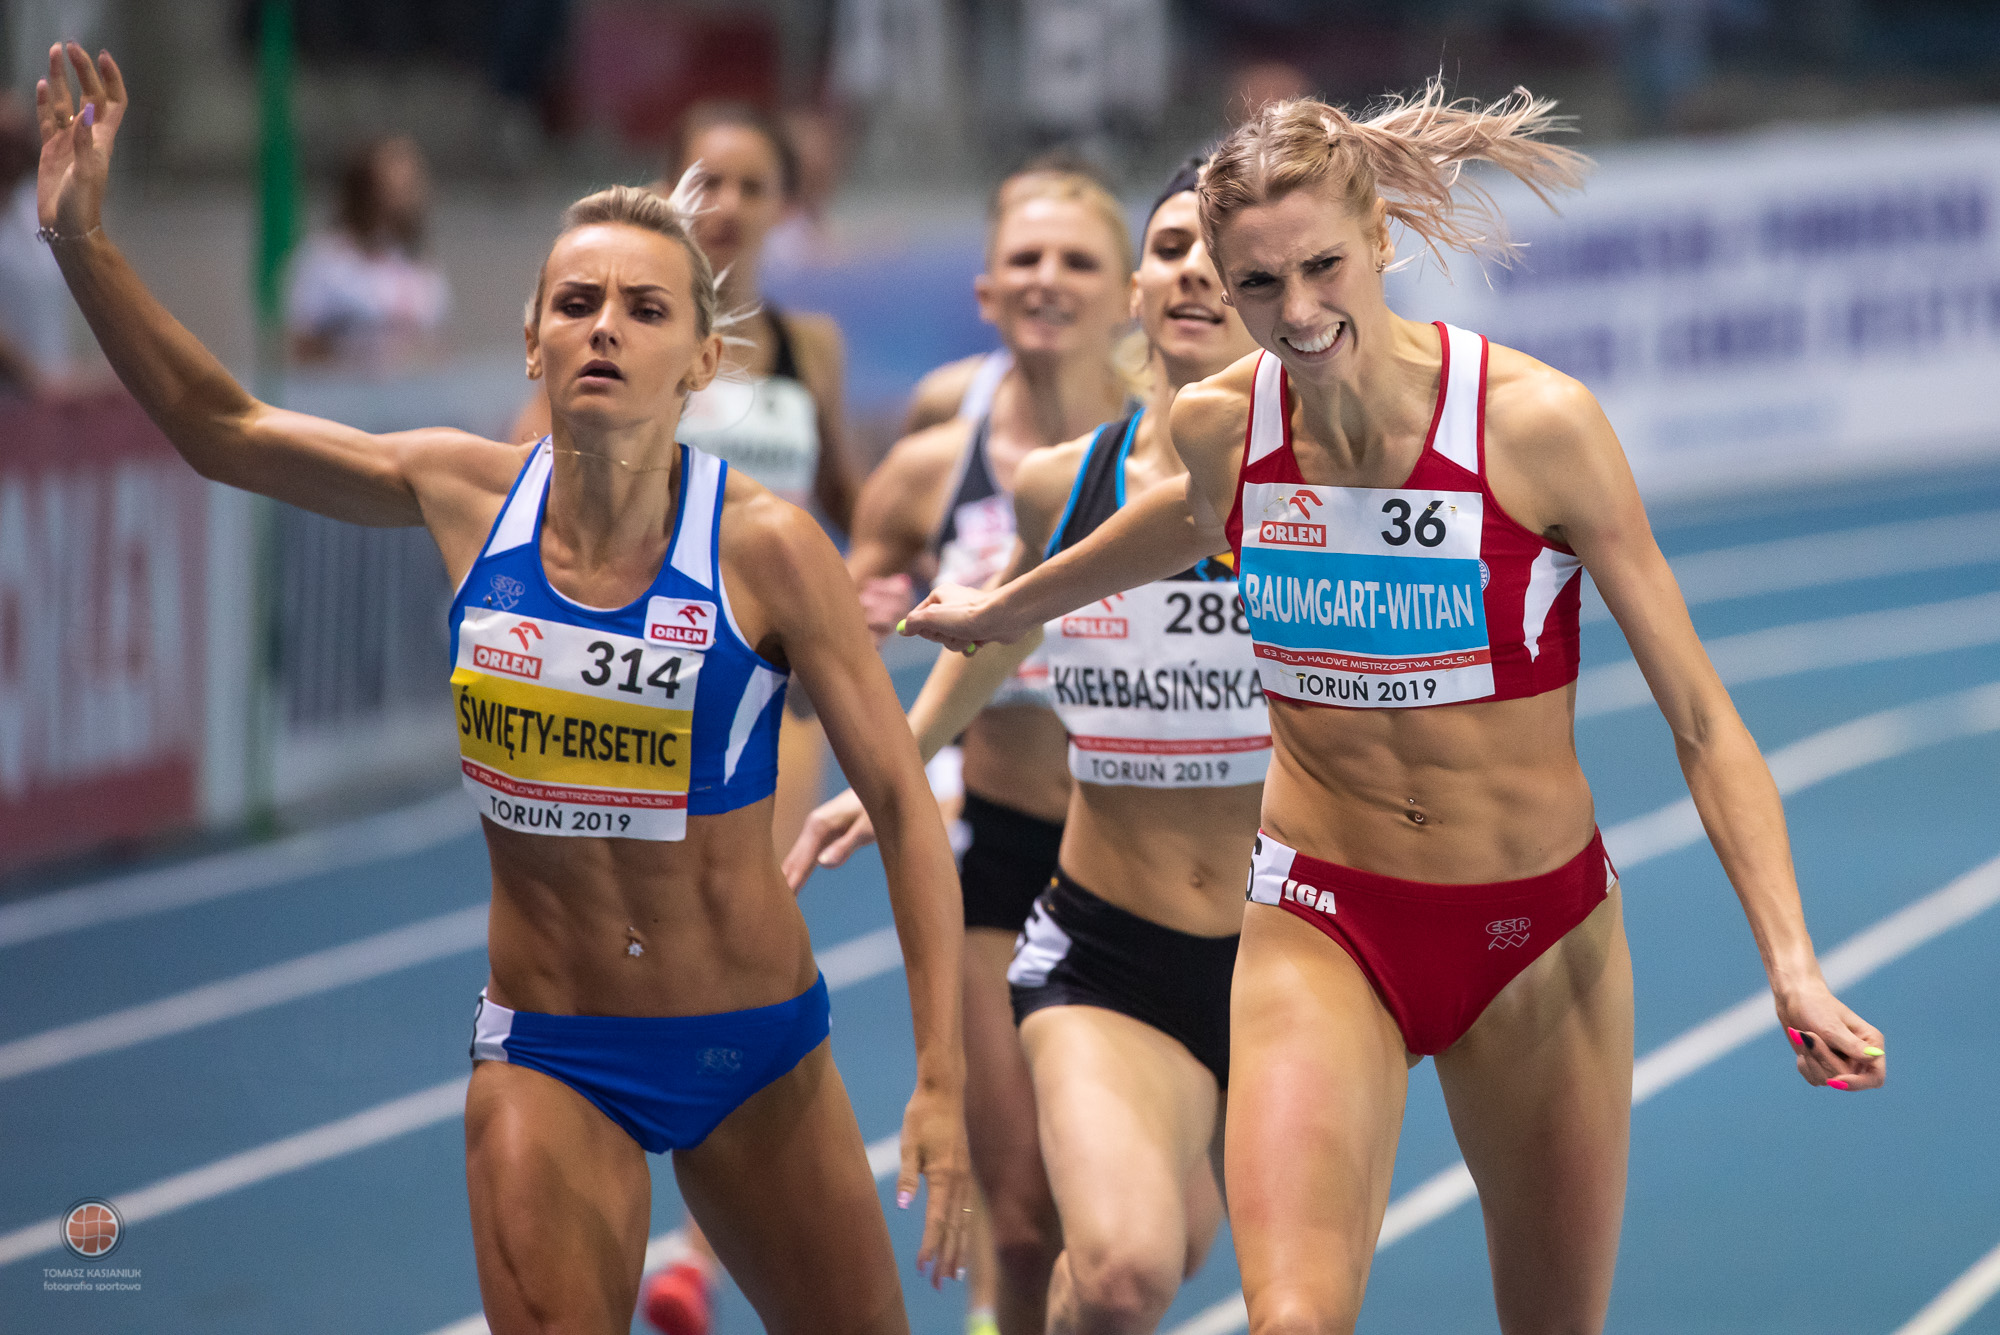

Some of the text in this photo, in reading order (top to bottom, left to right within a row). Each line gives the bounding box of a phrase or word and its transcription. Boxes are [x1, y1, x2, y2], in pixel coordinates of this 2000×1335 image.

[1262, 524, 1322, 544] ORLEN
[1381, 498, 1447, 548] 36
[1245, 573, 1475, 630] BAUMGART-WITAN
[654, 625, 705, 643] ORLEN
[1066, 619, 1125, 636] ORLEN
[475, 648, 539, 677] ORLEN
[581, 641, 682, 699] 314
[1280, 653, 1306, 663] PZLA
[1307, 656, 1348, 667] HALOWE
[1350, 660, 1432, 671] MISTRZOSTWA
[1433, 655, 1475, 666] POLSKI
[1054, 659, 1268, 711] KIEŁBASIŃSKA
[1296, 673, 1437, 702] TORUŃ 2019
[459, 685, 678, 768] ŚWIĘTY-ERSETIC
[1173, 760, 1231, 782] 2019
[500, 781, 543, 796] HALOWE
[545, 790, 630, 804] MISTRZOSTWA
[631, 797, 673, 807] POLSKI
[490, 796, 632, 832] TORUŃ 2019
